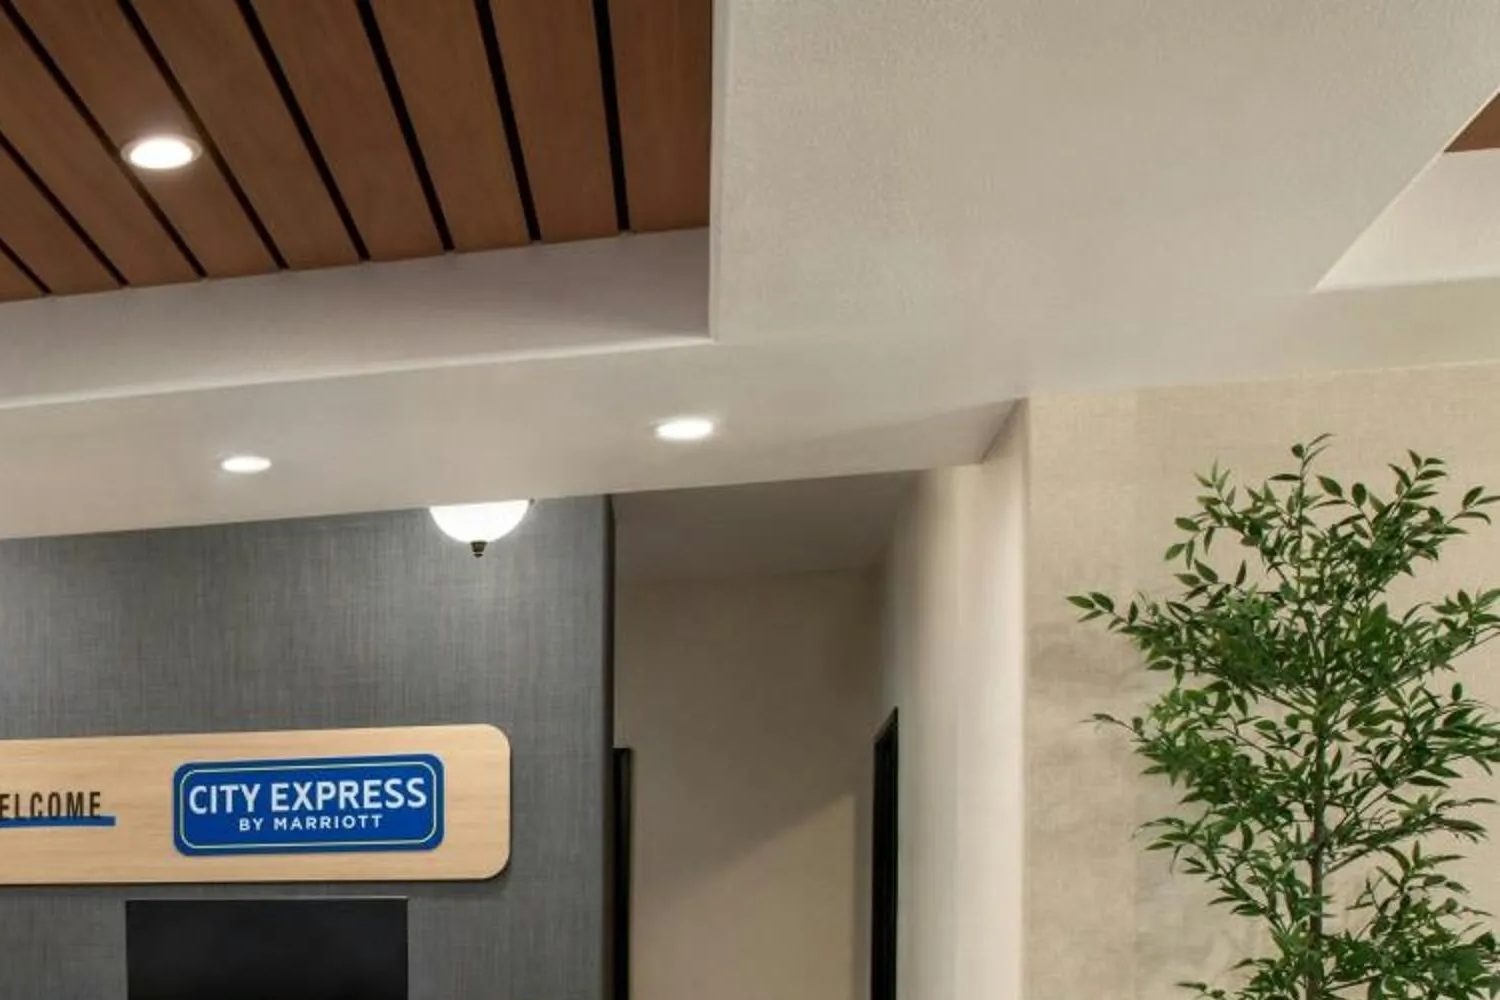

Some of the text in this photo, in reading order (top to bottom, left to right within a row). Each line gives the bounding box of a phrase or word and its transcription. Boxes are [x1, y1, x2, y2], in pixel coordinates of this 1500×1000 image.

[188, 777, 427, 815] CITY EXPRESS
[238, 814, 383, 832] BY MARRIOTT
